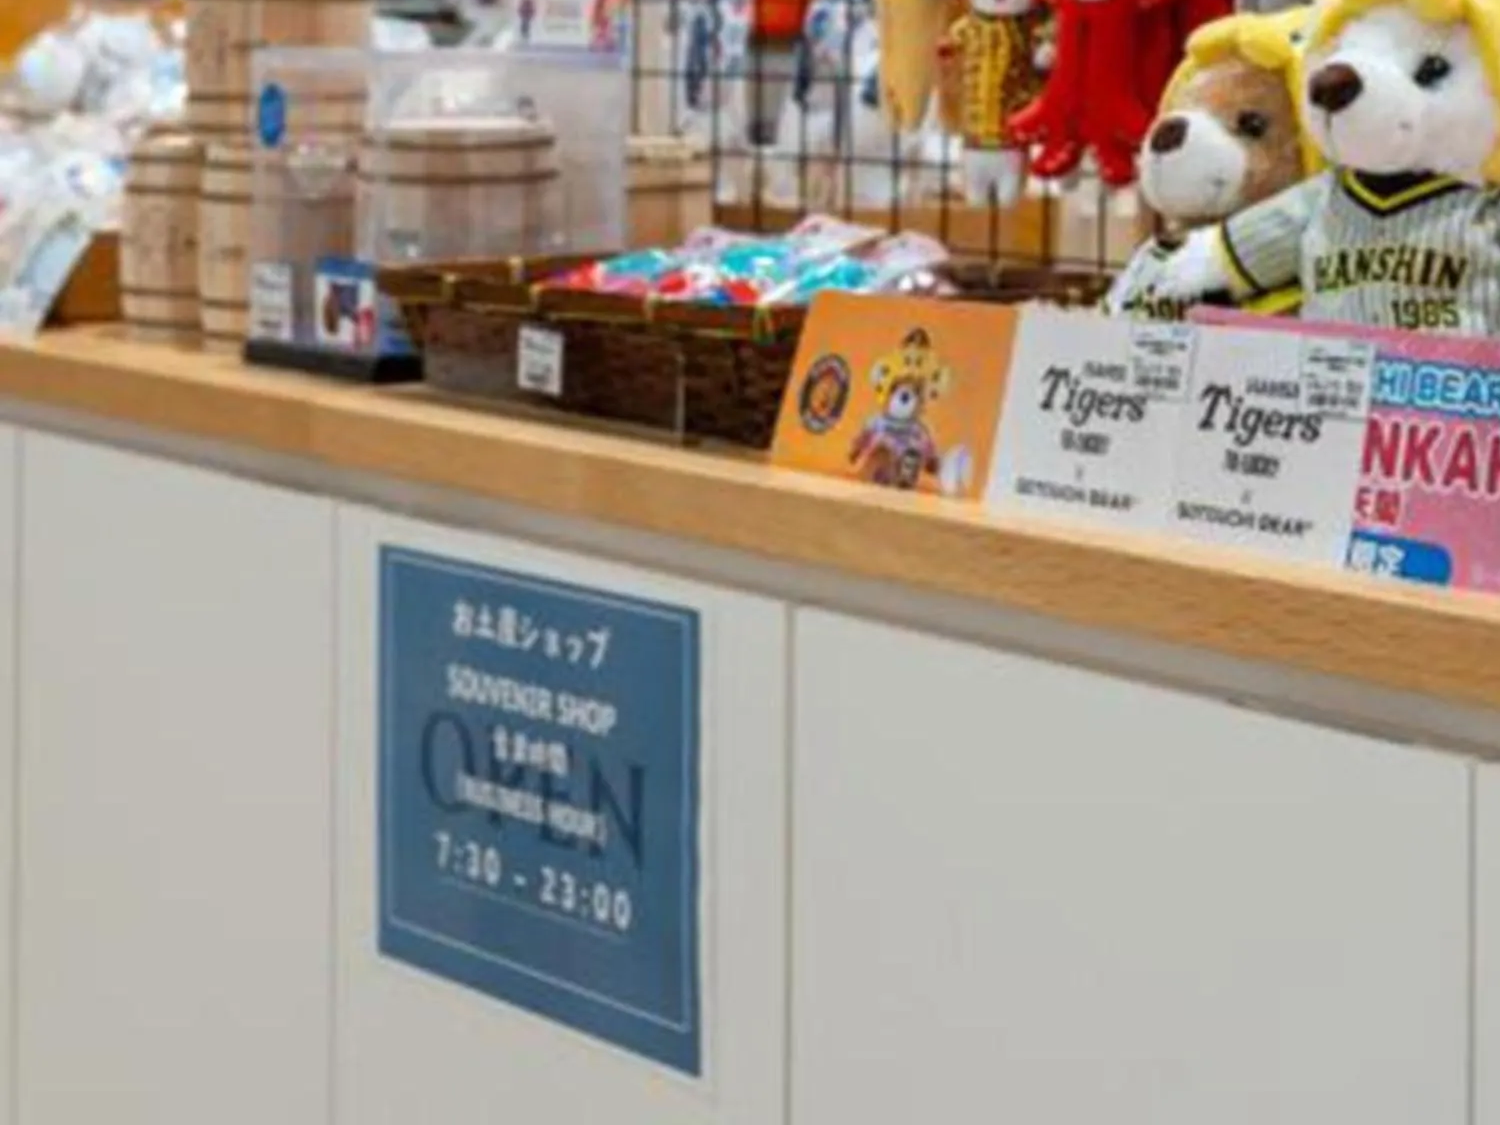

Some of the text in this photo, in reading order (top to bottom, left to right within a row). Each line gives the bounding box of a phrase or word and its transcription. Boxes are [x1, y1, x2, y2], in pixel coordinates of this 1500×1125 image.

[1313, 244, 1468, 292] HANSHIN
[1390, 299, 1460, 330] 1985
[1040, 364, 1147, 427] Tigers
[1198, 383, 1323, 447] Tigers
[556, 689, 617, 737] SHOP
[434, 831, 501, 887] 7:30
[539, 863, 632, 932] 23:00
